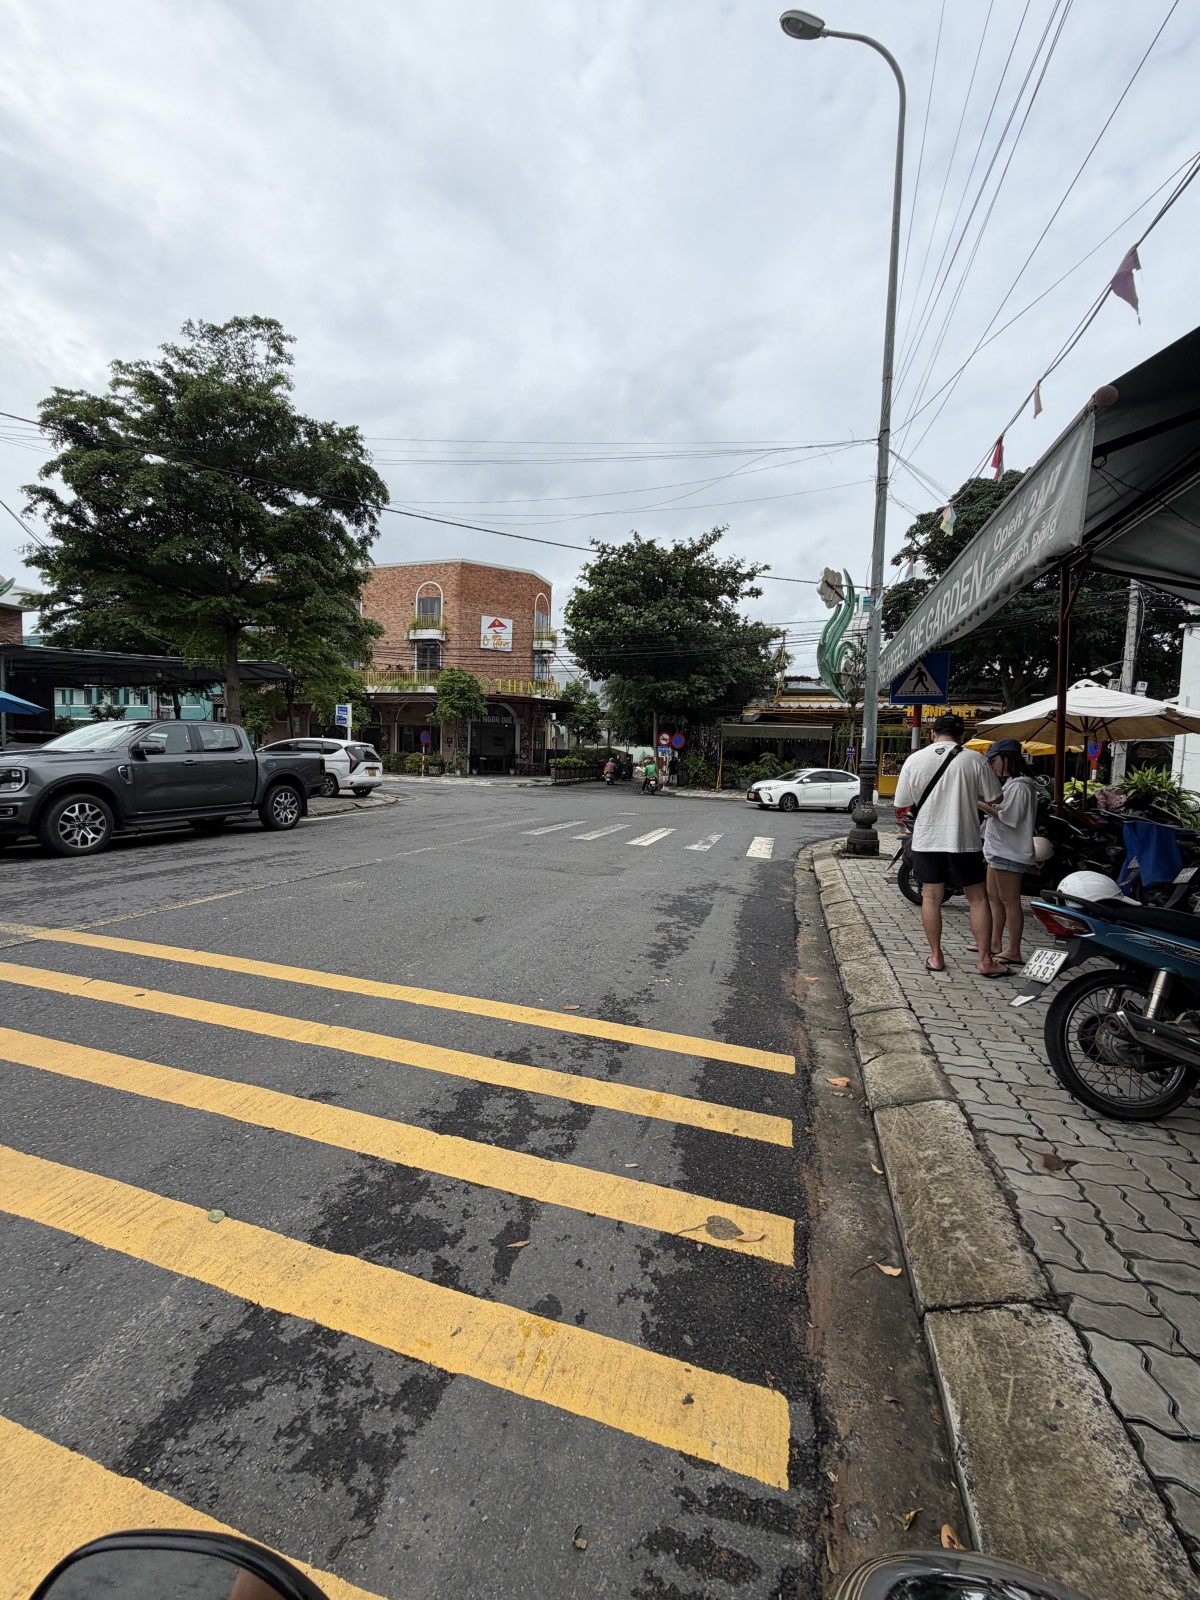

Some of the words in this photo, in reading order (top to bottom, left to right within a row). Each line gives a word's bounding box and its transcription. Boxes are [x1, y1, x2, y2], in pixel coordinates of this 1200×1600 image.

[993, 506, 1027, 552] Open:
[1028, 460, 1063, 518] 24/7
[909, 616, 925, 658] THE
[925, 551, 986, 642] GARDEN
